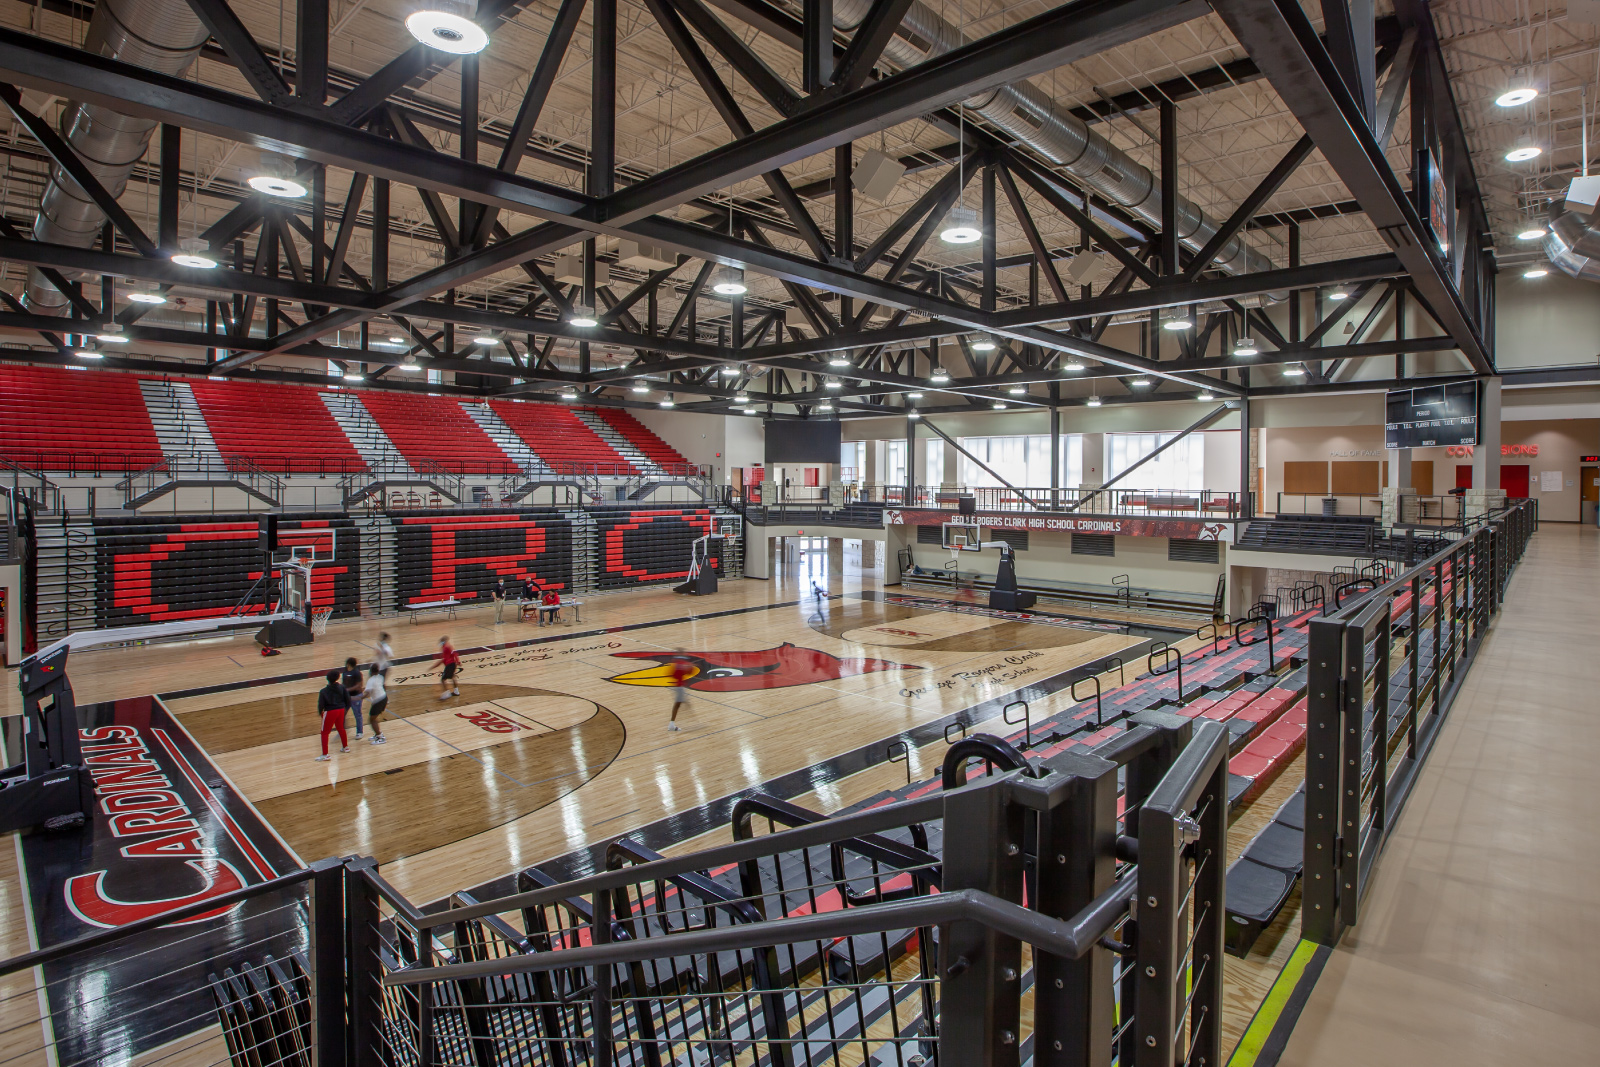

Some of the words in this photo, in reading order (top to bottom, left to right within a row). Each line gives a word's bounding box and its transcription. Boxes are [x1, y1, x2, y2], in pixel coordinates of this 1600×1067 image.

[1460, 437, 1474, 445] SCORE
[1446, 444, 1539, 455] CONSIONS
[976, 516, 1003, 527] ROGERS
[1004, 517, 1027, 527] CLARK
[1028, 518, 1045, 528] HIGH
[1047, 519, 1076, 530] SCHOOL
[1077, 520, 1121, 532] CARDINALS
[454, 711, 521, 733] GRC
